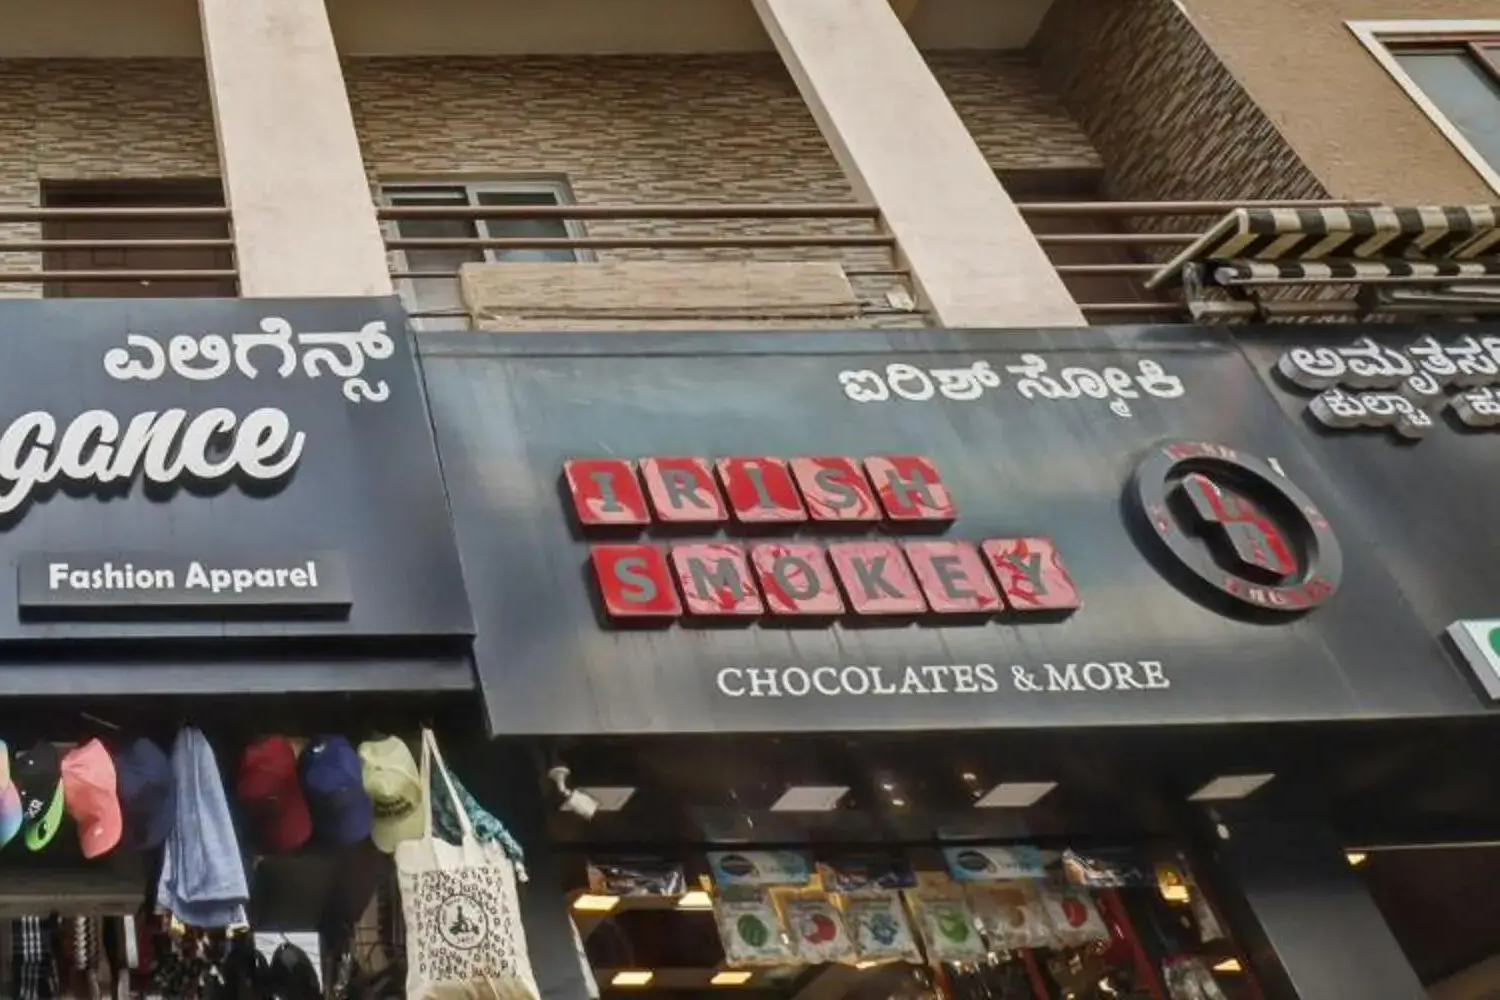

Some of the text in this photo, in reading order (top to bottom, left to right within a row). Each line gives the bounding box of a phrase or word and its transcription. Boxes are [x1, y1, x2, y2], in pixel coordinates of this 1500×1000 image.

[103, 317, 395, 404] ಎಲಿಗೆನ್ಸ್
[586, 465, 942, 516] IRISH
[49, 560, 319, 593] Fashion Apparel
[612, 553, 1052, 604] SMOKEY
[716, 663, 1000, 697] CHOCOLATES
